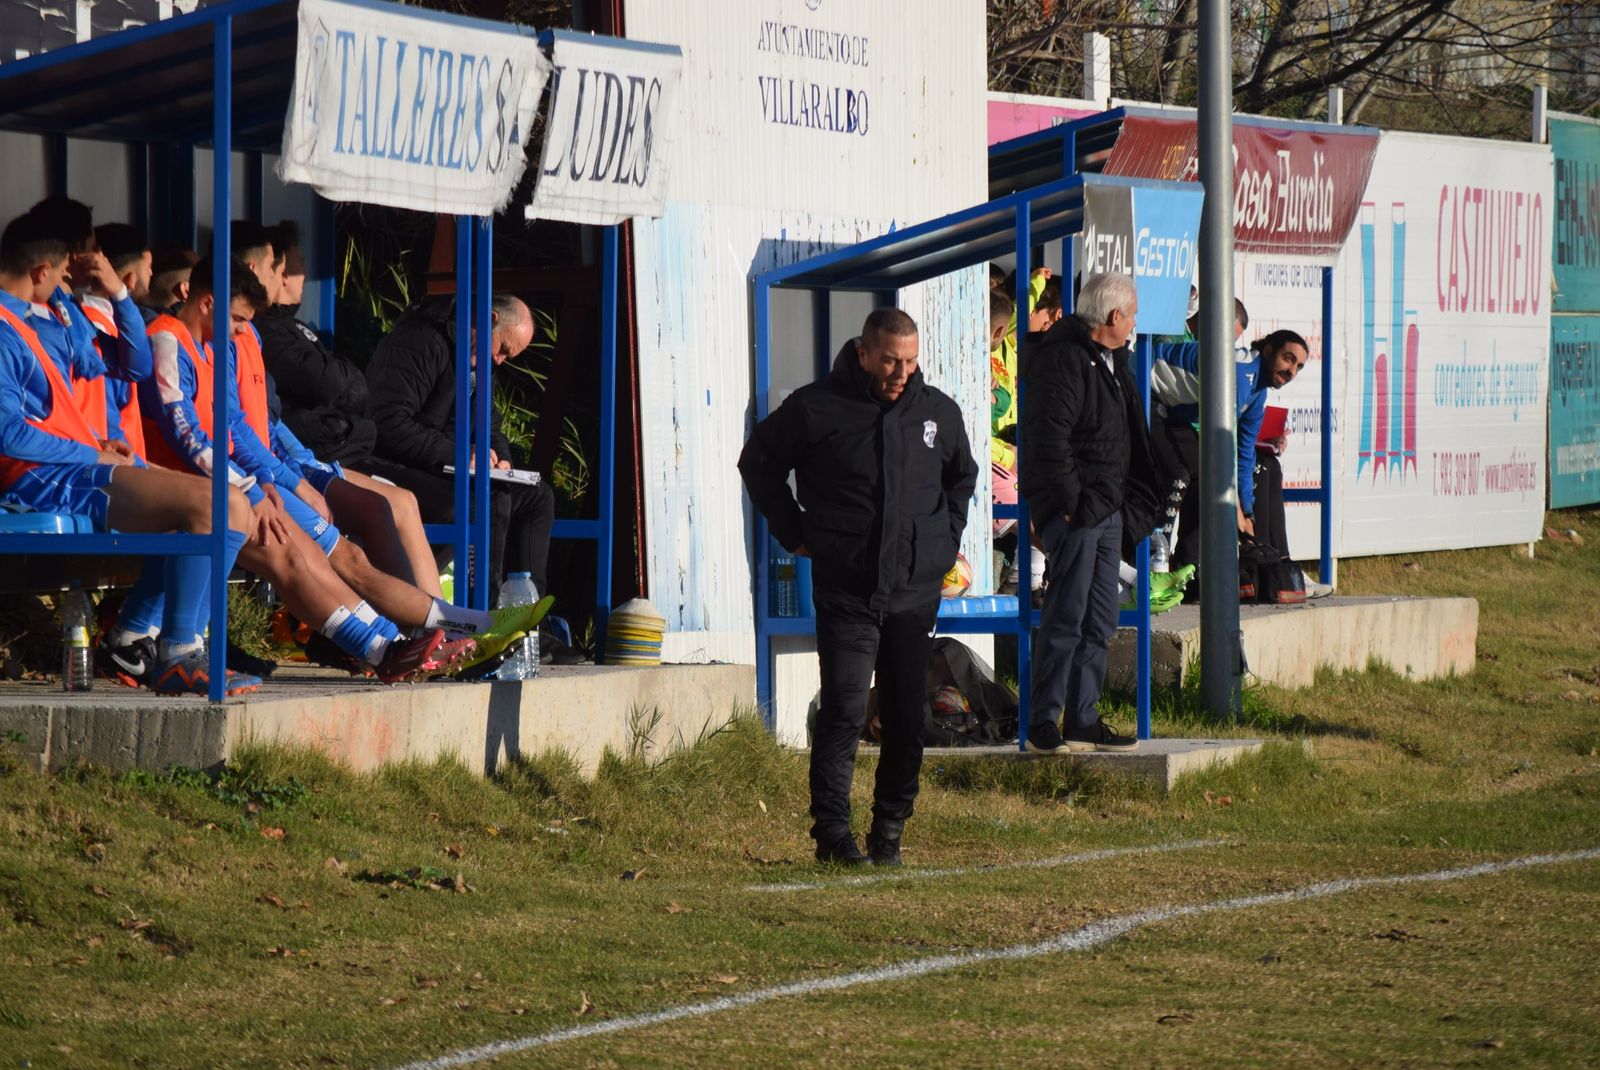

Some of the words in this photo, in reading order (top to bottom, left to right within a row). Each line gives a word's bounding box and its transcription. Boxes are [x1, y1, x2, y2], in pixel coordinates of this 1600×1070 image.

[757, 21, 851, 65] AYUNTAMIENTO
[852, 36, 869, 67] DE
[333, 30, 490, 173] TALLERES
[757, 75, 869, 136] VILLARALBO
[1232, 144, 1273, 230] asa
[1270, 150, 1335, 234] Aurelia
[1437, 184, 1543, 316] CASTILVIEJO
[1434, 338, 1487, 408] corredores
[1490, 338, 1501, 407] de
[1504, 363, 1538, 422] seguros
[1292, 400, 1338, 446] empotros
